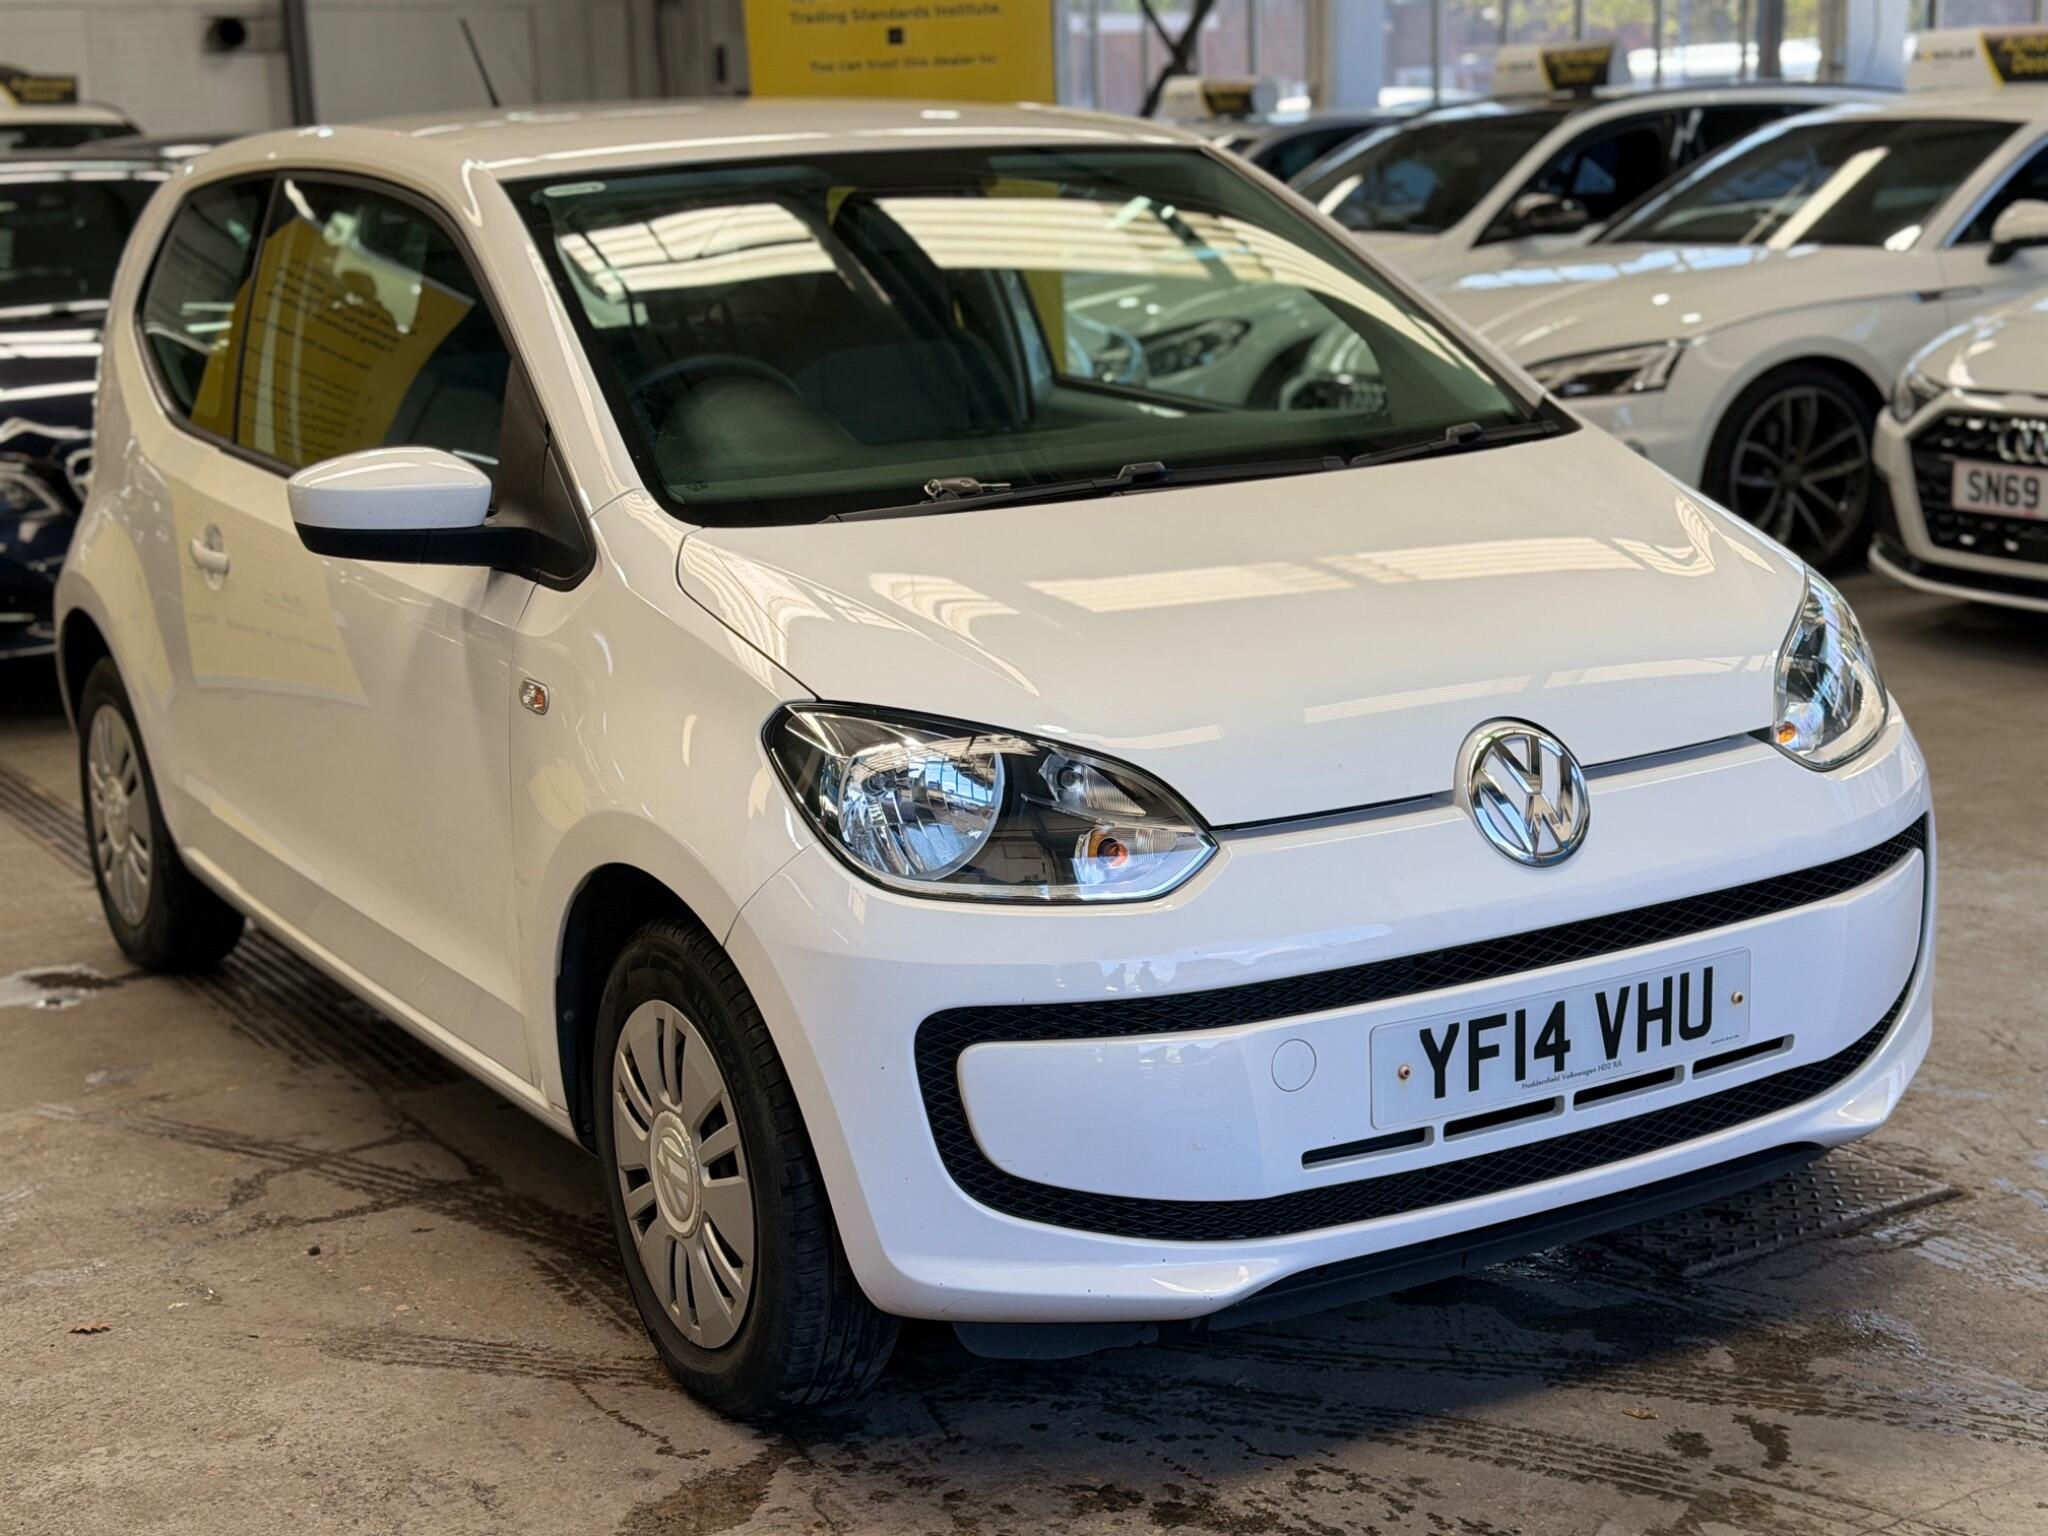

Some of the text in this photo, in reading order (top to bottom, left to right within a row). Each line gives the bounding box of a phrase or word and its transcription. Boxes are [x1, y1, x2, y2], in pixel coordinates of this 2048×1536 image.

[852, 7, 930, 22] Standards
[1967, 469, 2040, 509] SN69
[1419, 966, 1714, 1099] YF14 VHU
